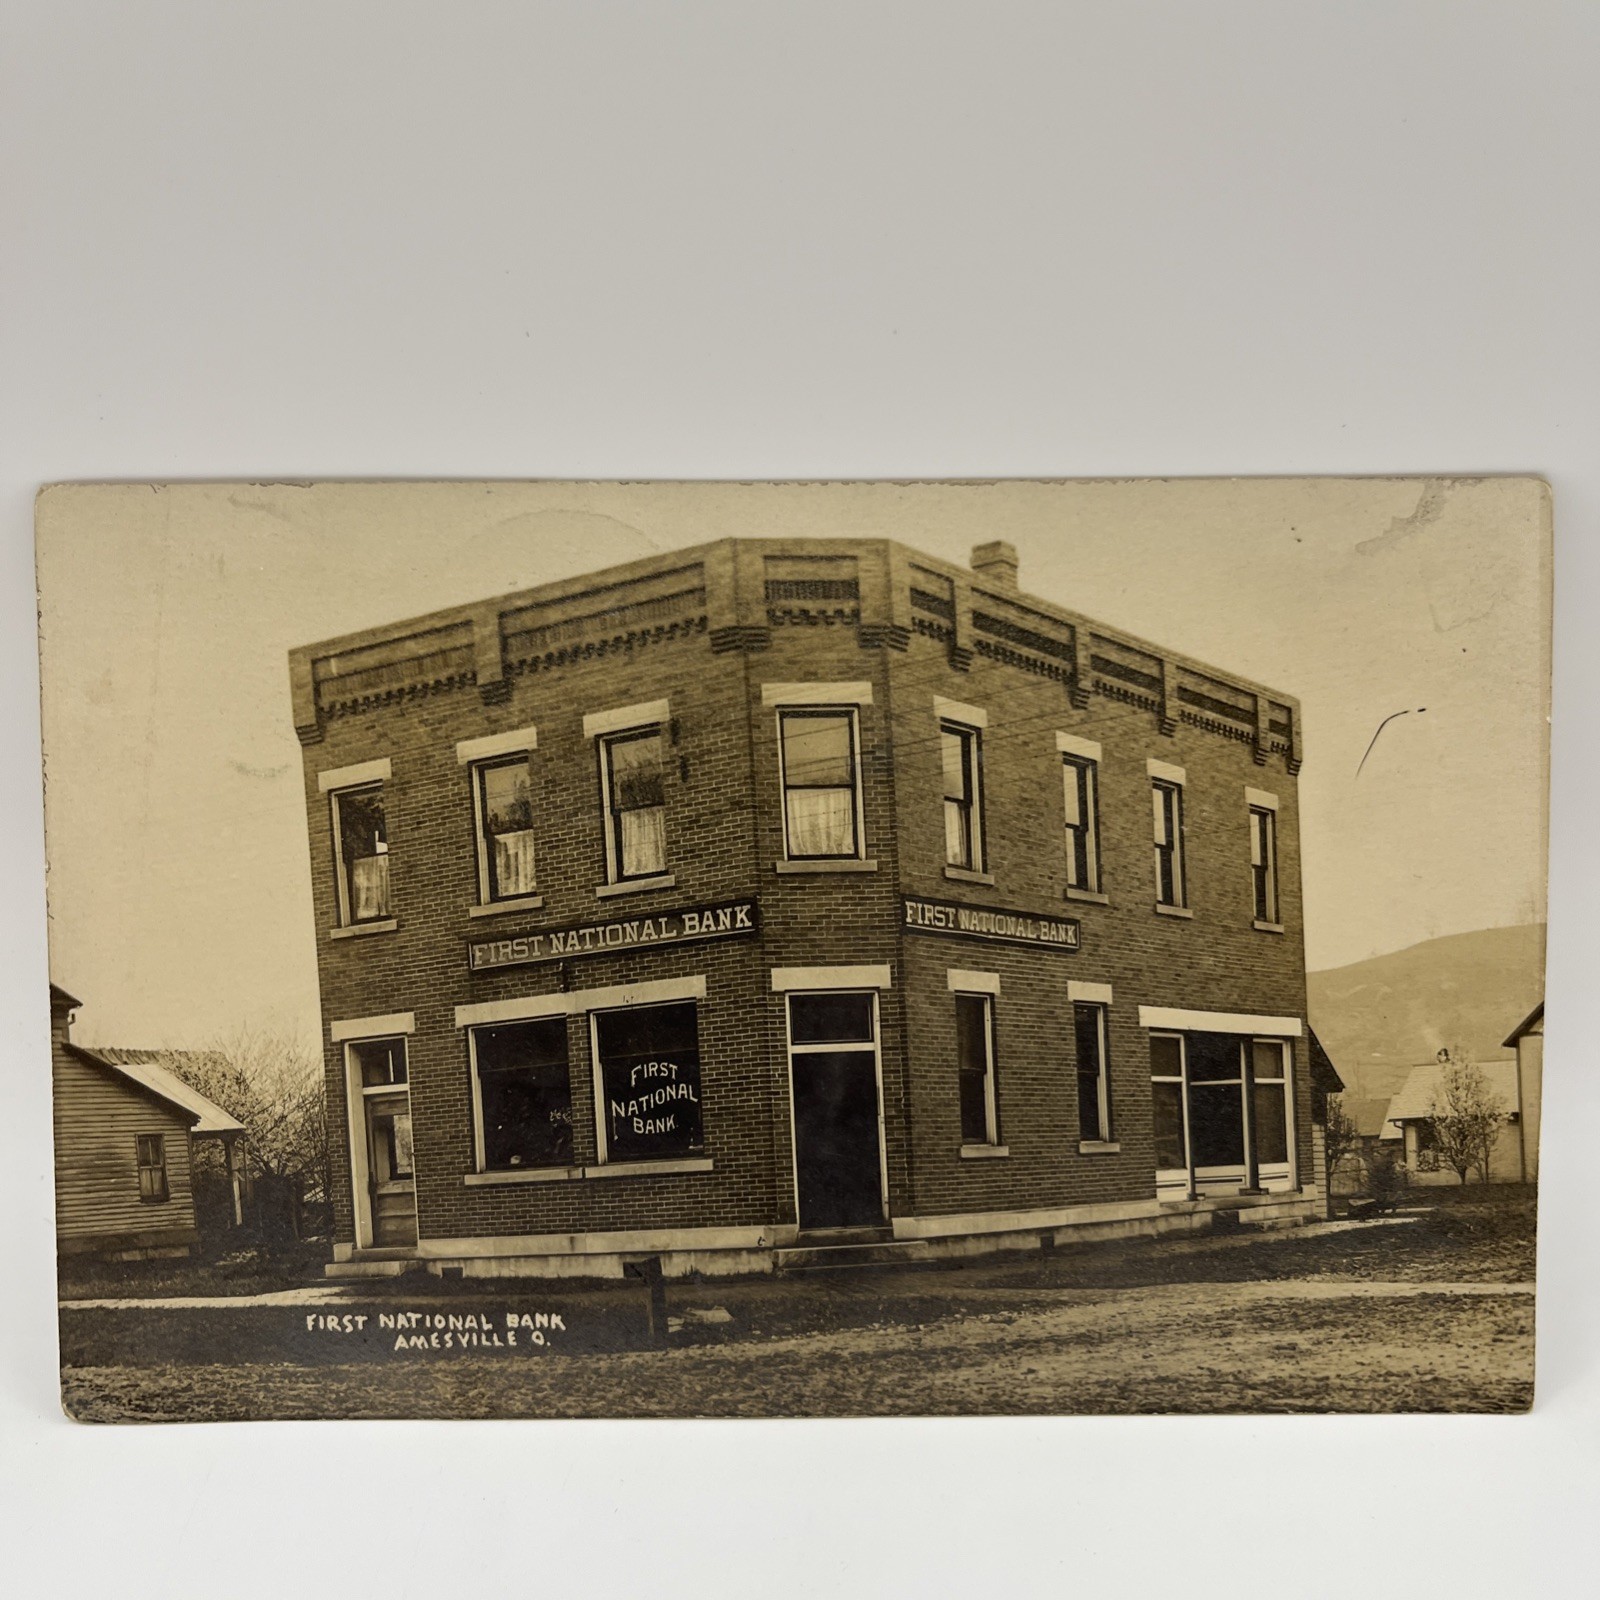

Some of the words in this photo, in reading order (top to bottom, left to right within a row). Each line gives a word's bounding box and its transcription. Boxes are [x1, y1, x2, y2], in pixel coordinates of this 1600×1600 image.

[473, 935, 543, 965] FIRST
[550, 917, 677, 954] NATIONAL
[682, 905, 752, 934] BANK
[905, 901, 956, 928] FIRST
[960, 911, 1036, 939] NATIONAL
[1039, 921, 1077, 944] BANK
[631, 1062, 678, 1087] FIRST
[612, 1083, 698, 1117] NATIONAL
[306, 1313, 368, 1333] FIRST
[379, 1312, 493, 1331] NATIONAL
[506, 1312, 566, 1331] BANK
[394, 1330, 518, 1351] AMESVILLE
